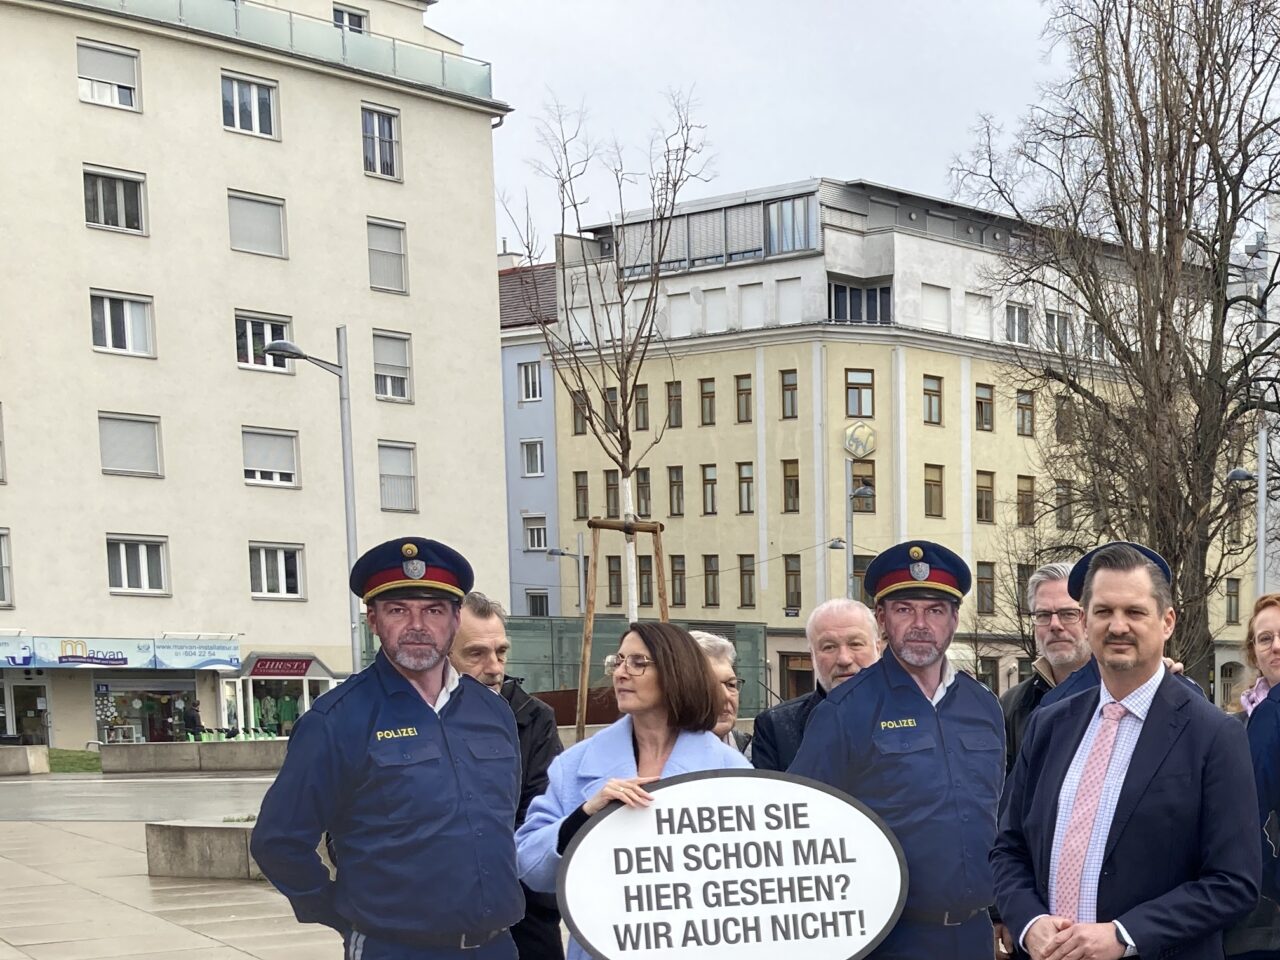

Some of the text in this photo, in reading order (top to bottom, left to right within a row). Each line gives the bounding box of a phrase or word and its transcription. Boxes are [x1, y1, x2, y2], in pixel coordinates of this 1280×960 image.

[256, 661, 307, 669] CHRISTA
[376, 727, 418, 741] POLIZEI
[880, 718, 917, 730] POLIZEI
[655, 802, 810, 835] HABEN SIE
[613, 837, 857, 875] DEN SCHON MAL
[624, 873, 851, 912] HIER GESEHEN?
[613, 910, 867, 951] WIR AUCH NICHT!
